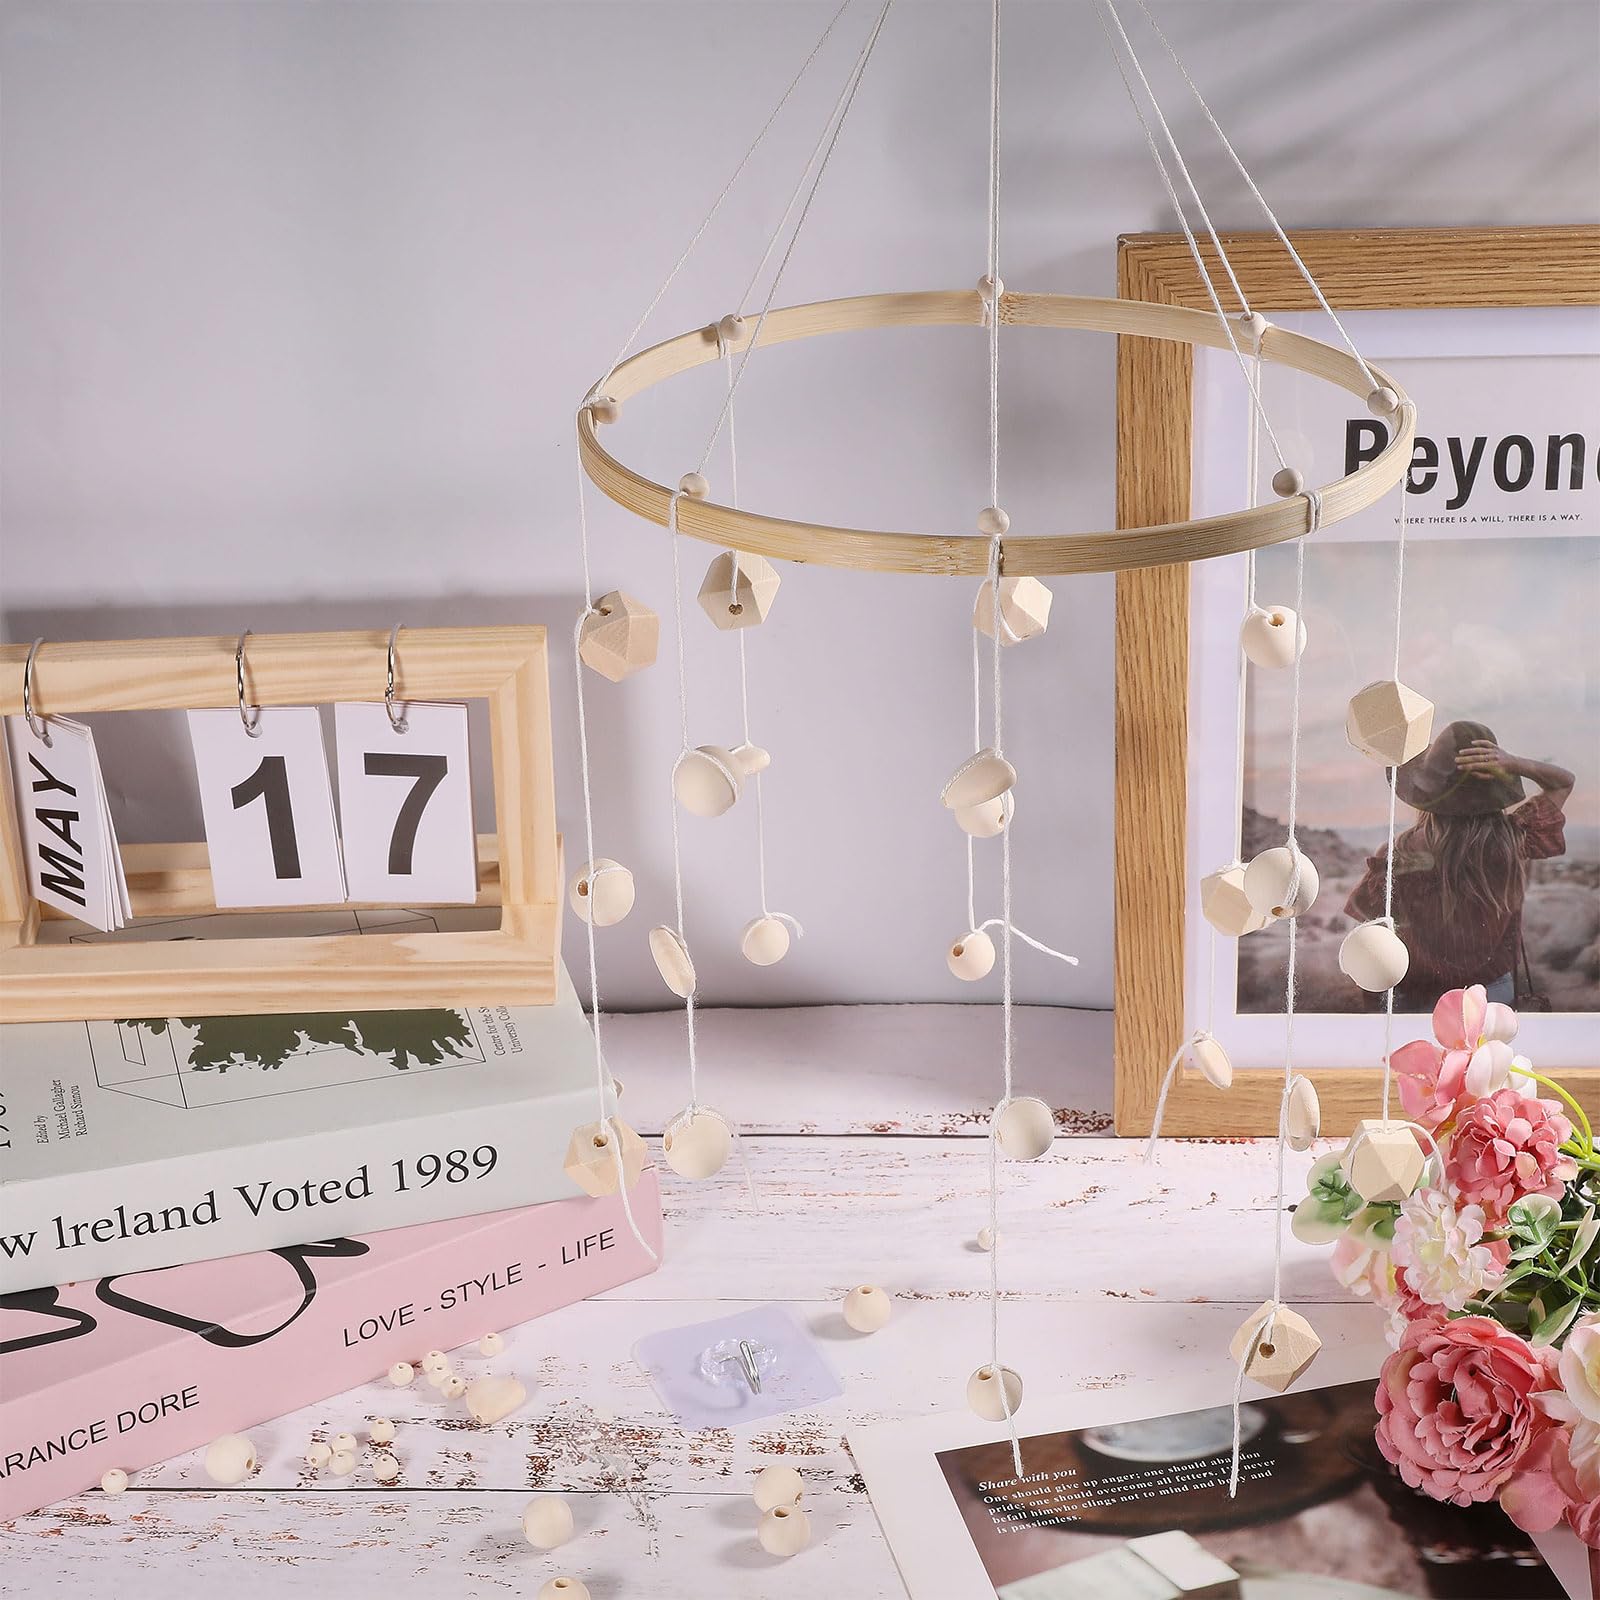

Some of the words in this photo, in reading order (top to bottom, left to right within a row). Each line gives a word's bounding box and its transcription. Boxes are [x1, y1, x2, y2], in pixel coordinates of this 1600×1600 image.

[1344, 419, 1600, 511] Beyon
[1428, 516, 1456, 525] THERE
[1459, 516, 1468, 524] IS
[1480, 515, 1504, 524] WILL,
[1508, 514, 1535, 523] THERE
[1538, 514, 1547, 522] IS
[1560, 513, 1584, 521] WAY.
[28, 752, 86, 907] MAY
[51, 1079, 66, 1112] Gallagher
[54, 1112, 71, 1140] Michael
[72, 1109, 88, 1137] Richard
[52, 1190, 222, 1250] Ireland
[233, 1164, 374, 1217] Voted
[392, 1145, 499, 1193] 1989
[343, 1303, 416, 1347] LOVE
[440, 1262, 523, 1310] STYLE
[561, 1228, 616, 1265] LIFE
[0, 1420, 109, 1479] RANCE
[116, 1385, 201, 1434] DORE
[978, 1478, 1018, 1492] Share
[1021, 1471, 1049, 1484] with
[1053, 1468, 1077, 1480] you
[983, 1495, 1009, 1504] One
[1011, 1486, 1052, 1499] should
[1055, 1482, 1079, 1493] give
[1082, 1480, 1098, 1488] up
[1143, 1469, 1164, 1477] one
[1167, 1461, 1207, 1474] should
[1210, 1452, 1261, 1466] abadon
[988, 1502, 1026, 1516] pride;
[1029, 1498, 1050, 1507] one
[1053, 1490, 1093, 1503] should
[1096, 1481, 1153, 1496] overcome
[1156, 1476, 1172, 1486] all
[1243, 1459, 1276, 1471] never
[991, 1511, 1027, 1524] befall
[1120, 1493, 1140, 1502] not
[1158, 1484, 1189, 1496] mind
[1192, 1480, 1215, 1490] and
[1250, 1469, 1273, 1480] and
[996, 1526, 1008, 1534] is
[1011, 1514, 1082, 1533] passionless.
